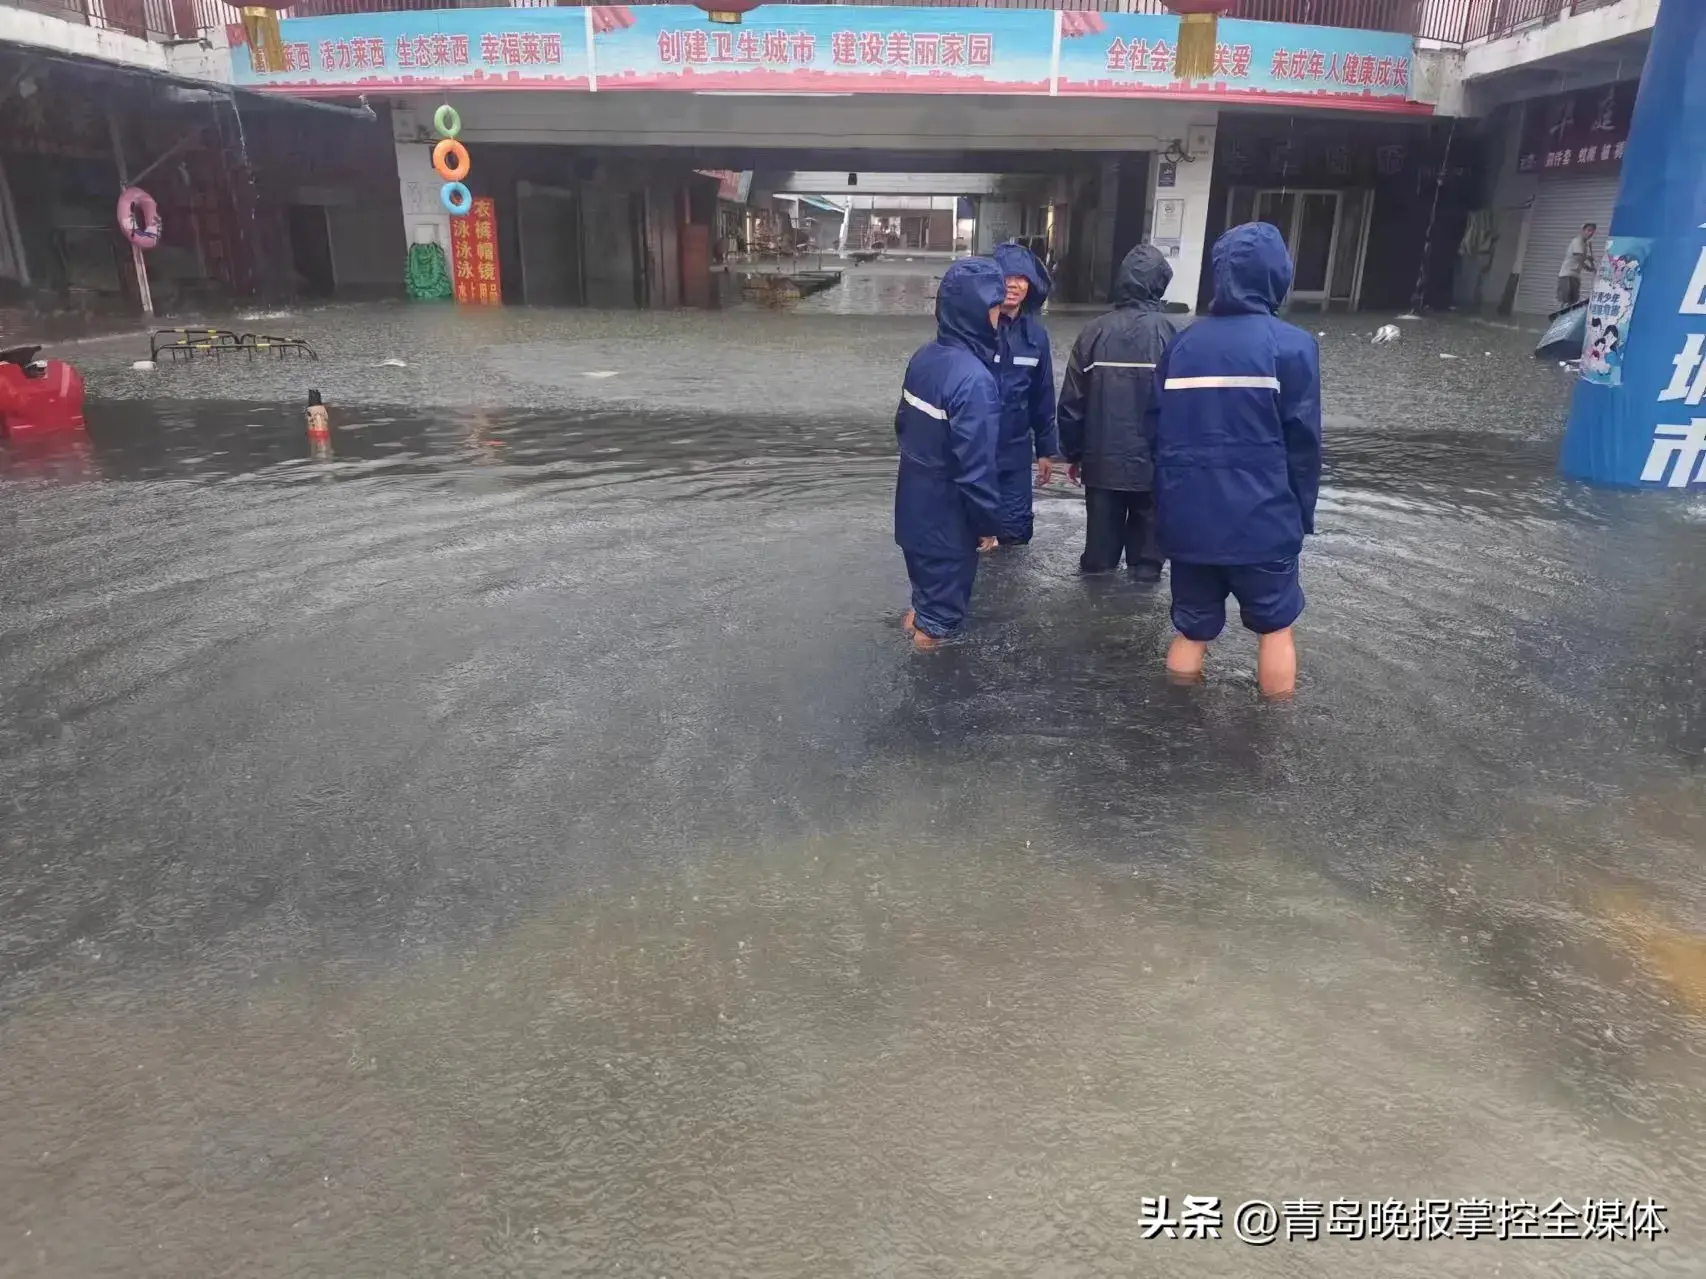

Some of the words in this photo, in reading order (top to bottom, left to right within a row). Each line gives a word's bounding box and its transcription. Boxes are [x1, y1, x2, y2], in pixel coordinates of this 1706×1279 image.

[319, 36, 386, 71] 活力莱西
[396, 32, 470, 67] 生态莱西
[481, 31, 563, 66] 幸福莱西
[657, 28, 817, 65] 创建卫生城市
[832, 30, 994, 67] 建设美丽家园
[1105, 37, 1252, 80] 全社会关爱
[1271, 47, 1408, 88] 未成年人健康成长
